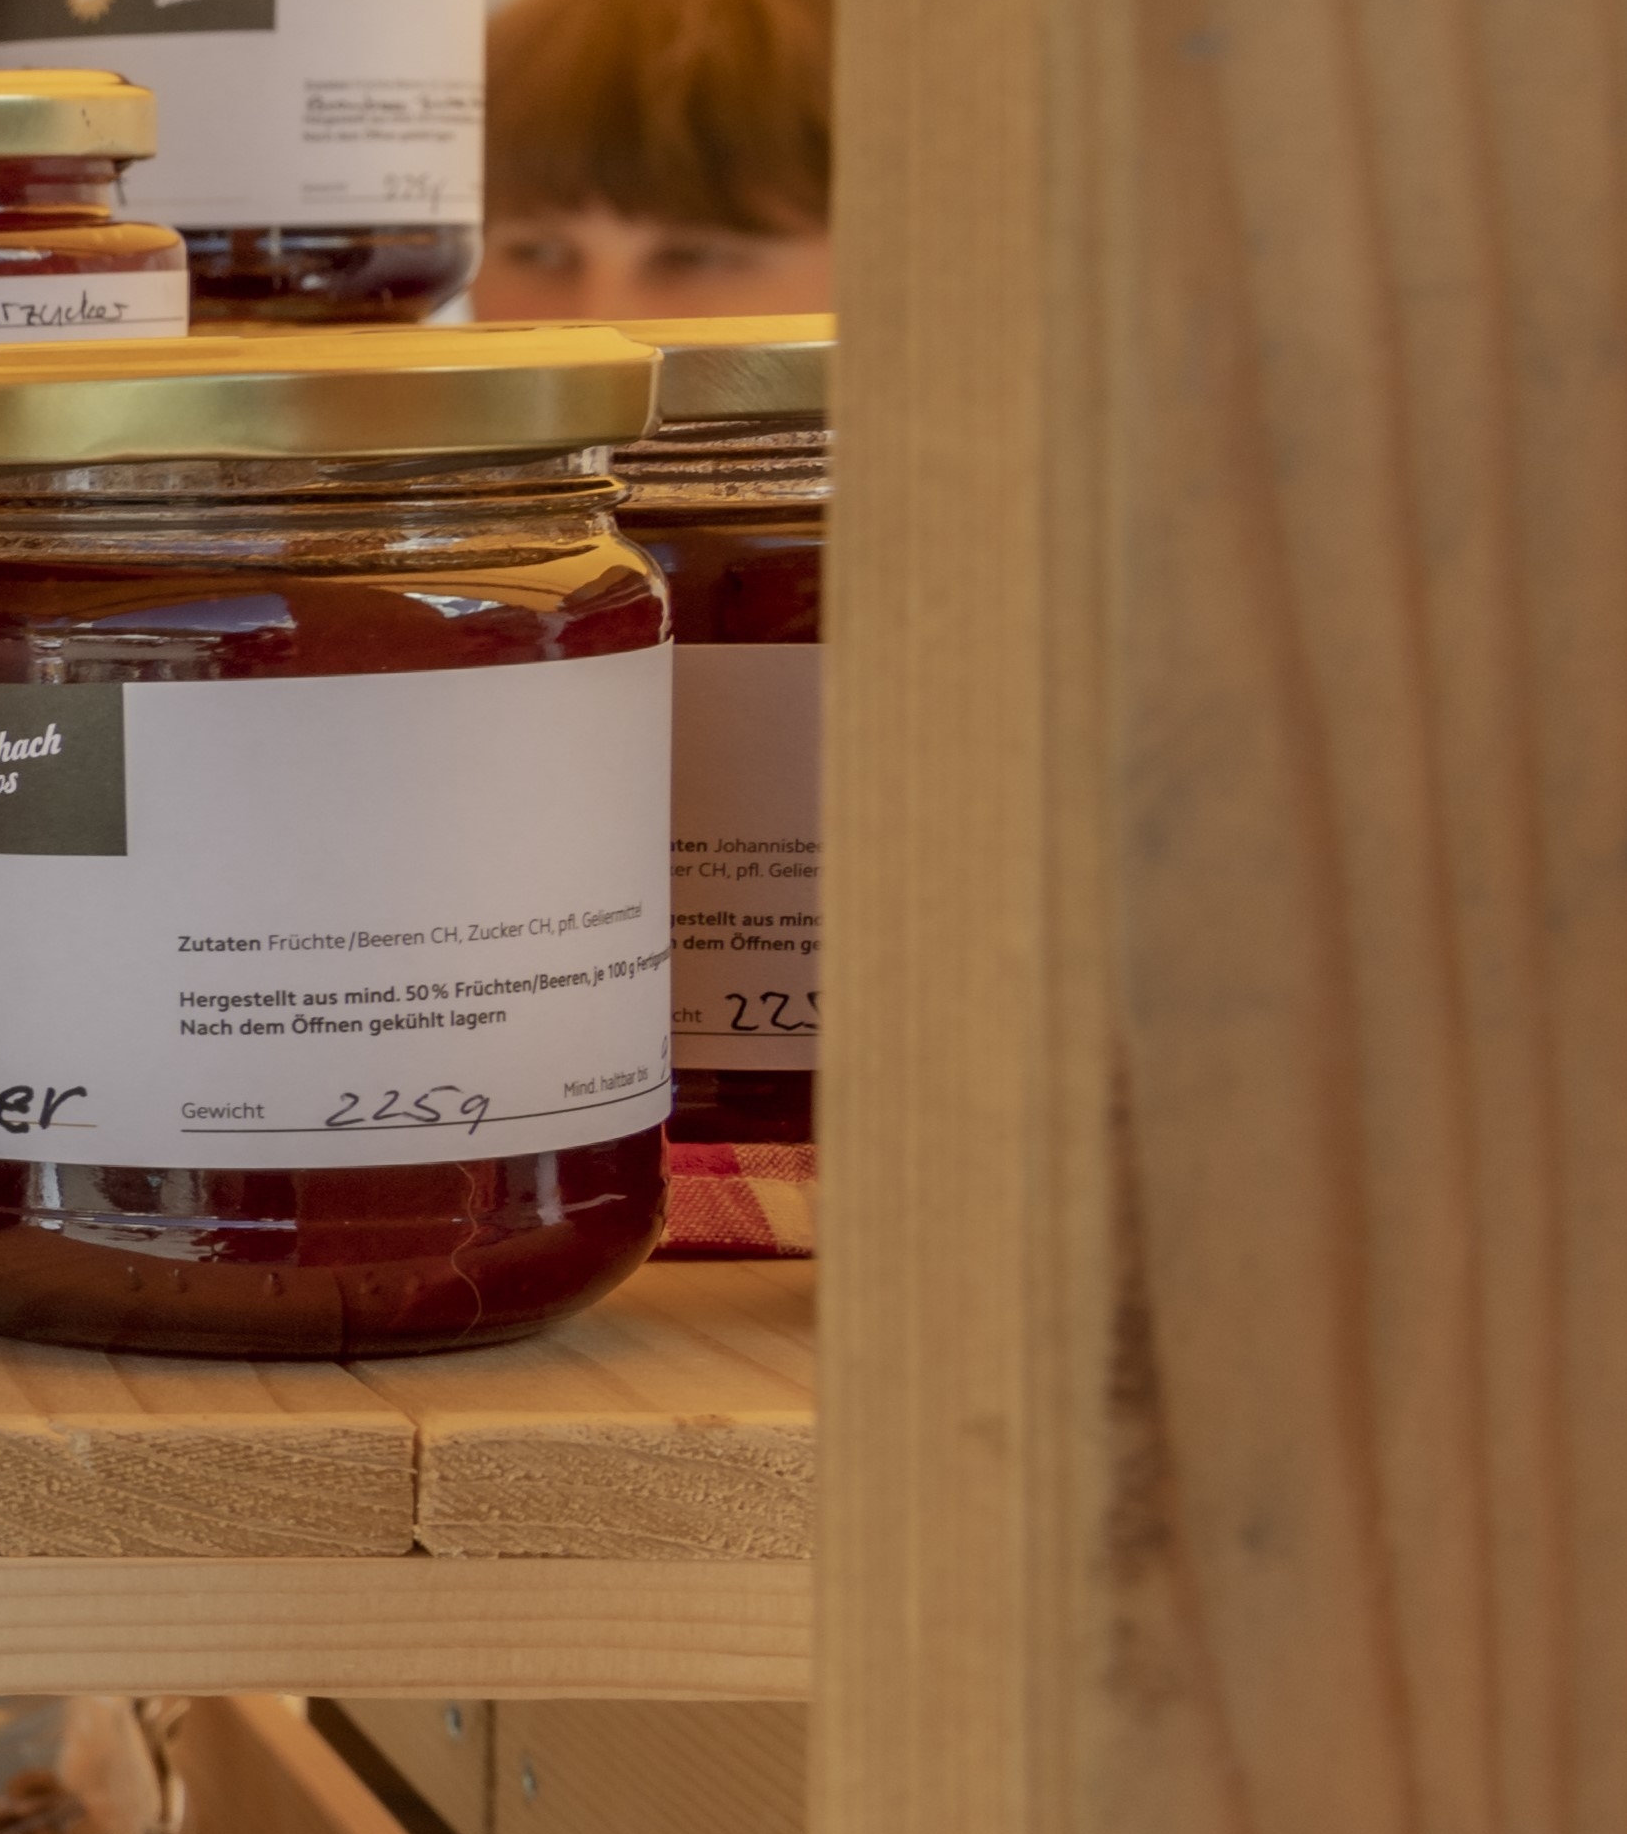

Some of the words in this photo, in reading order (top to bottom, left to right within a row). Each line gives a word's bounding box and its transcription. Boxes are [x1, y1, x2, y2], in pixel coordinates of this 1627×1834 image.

[699, 863, 731, 879] CH,
[736, 863, 764, 881] pfl.
[178, 936, 261, 952] Zutaten
[268, 930, 425, 951] Früchte/Beeren
[431, 926, 463, 944] CH,
[468, 922, 524, 941] Zucker
[529, 918, 555, 935] CH,
[558, 913, 580, 937] pfl.
[582, 901, 642, 928] Geliermittel
[742, 914, 774, 927] aus
[683, 936, 724, 951] dem
[730, 933, 796, 951] Öffnen
[179, 990, 297, 1012] Hergestellt
[302, 992, 338, 1006] aus
[344, 986, 400, 1004] mind.
[455, 974, 591, 998] Früchten/Beeren,
[593, 967, 604, 987] je
[608, 960, 627, 979] 100
[629, 962, 635, 979] g
[180, 1019, 233, 1035] Nach
[239, 1018, 285, 1035] dem
[292, 1014, 363, 1034] Öffnen
[369, 1012, 444, 1036] gekühlt
[450, 1009, 507, 1030] lagern
[181, 1102, 265, 1119] Gewicht
[564, 1081, 598, 1099] Mind.
[600, 1071, 636, 1093] haltbar
[637, 1065, 649, 1082] bis
